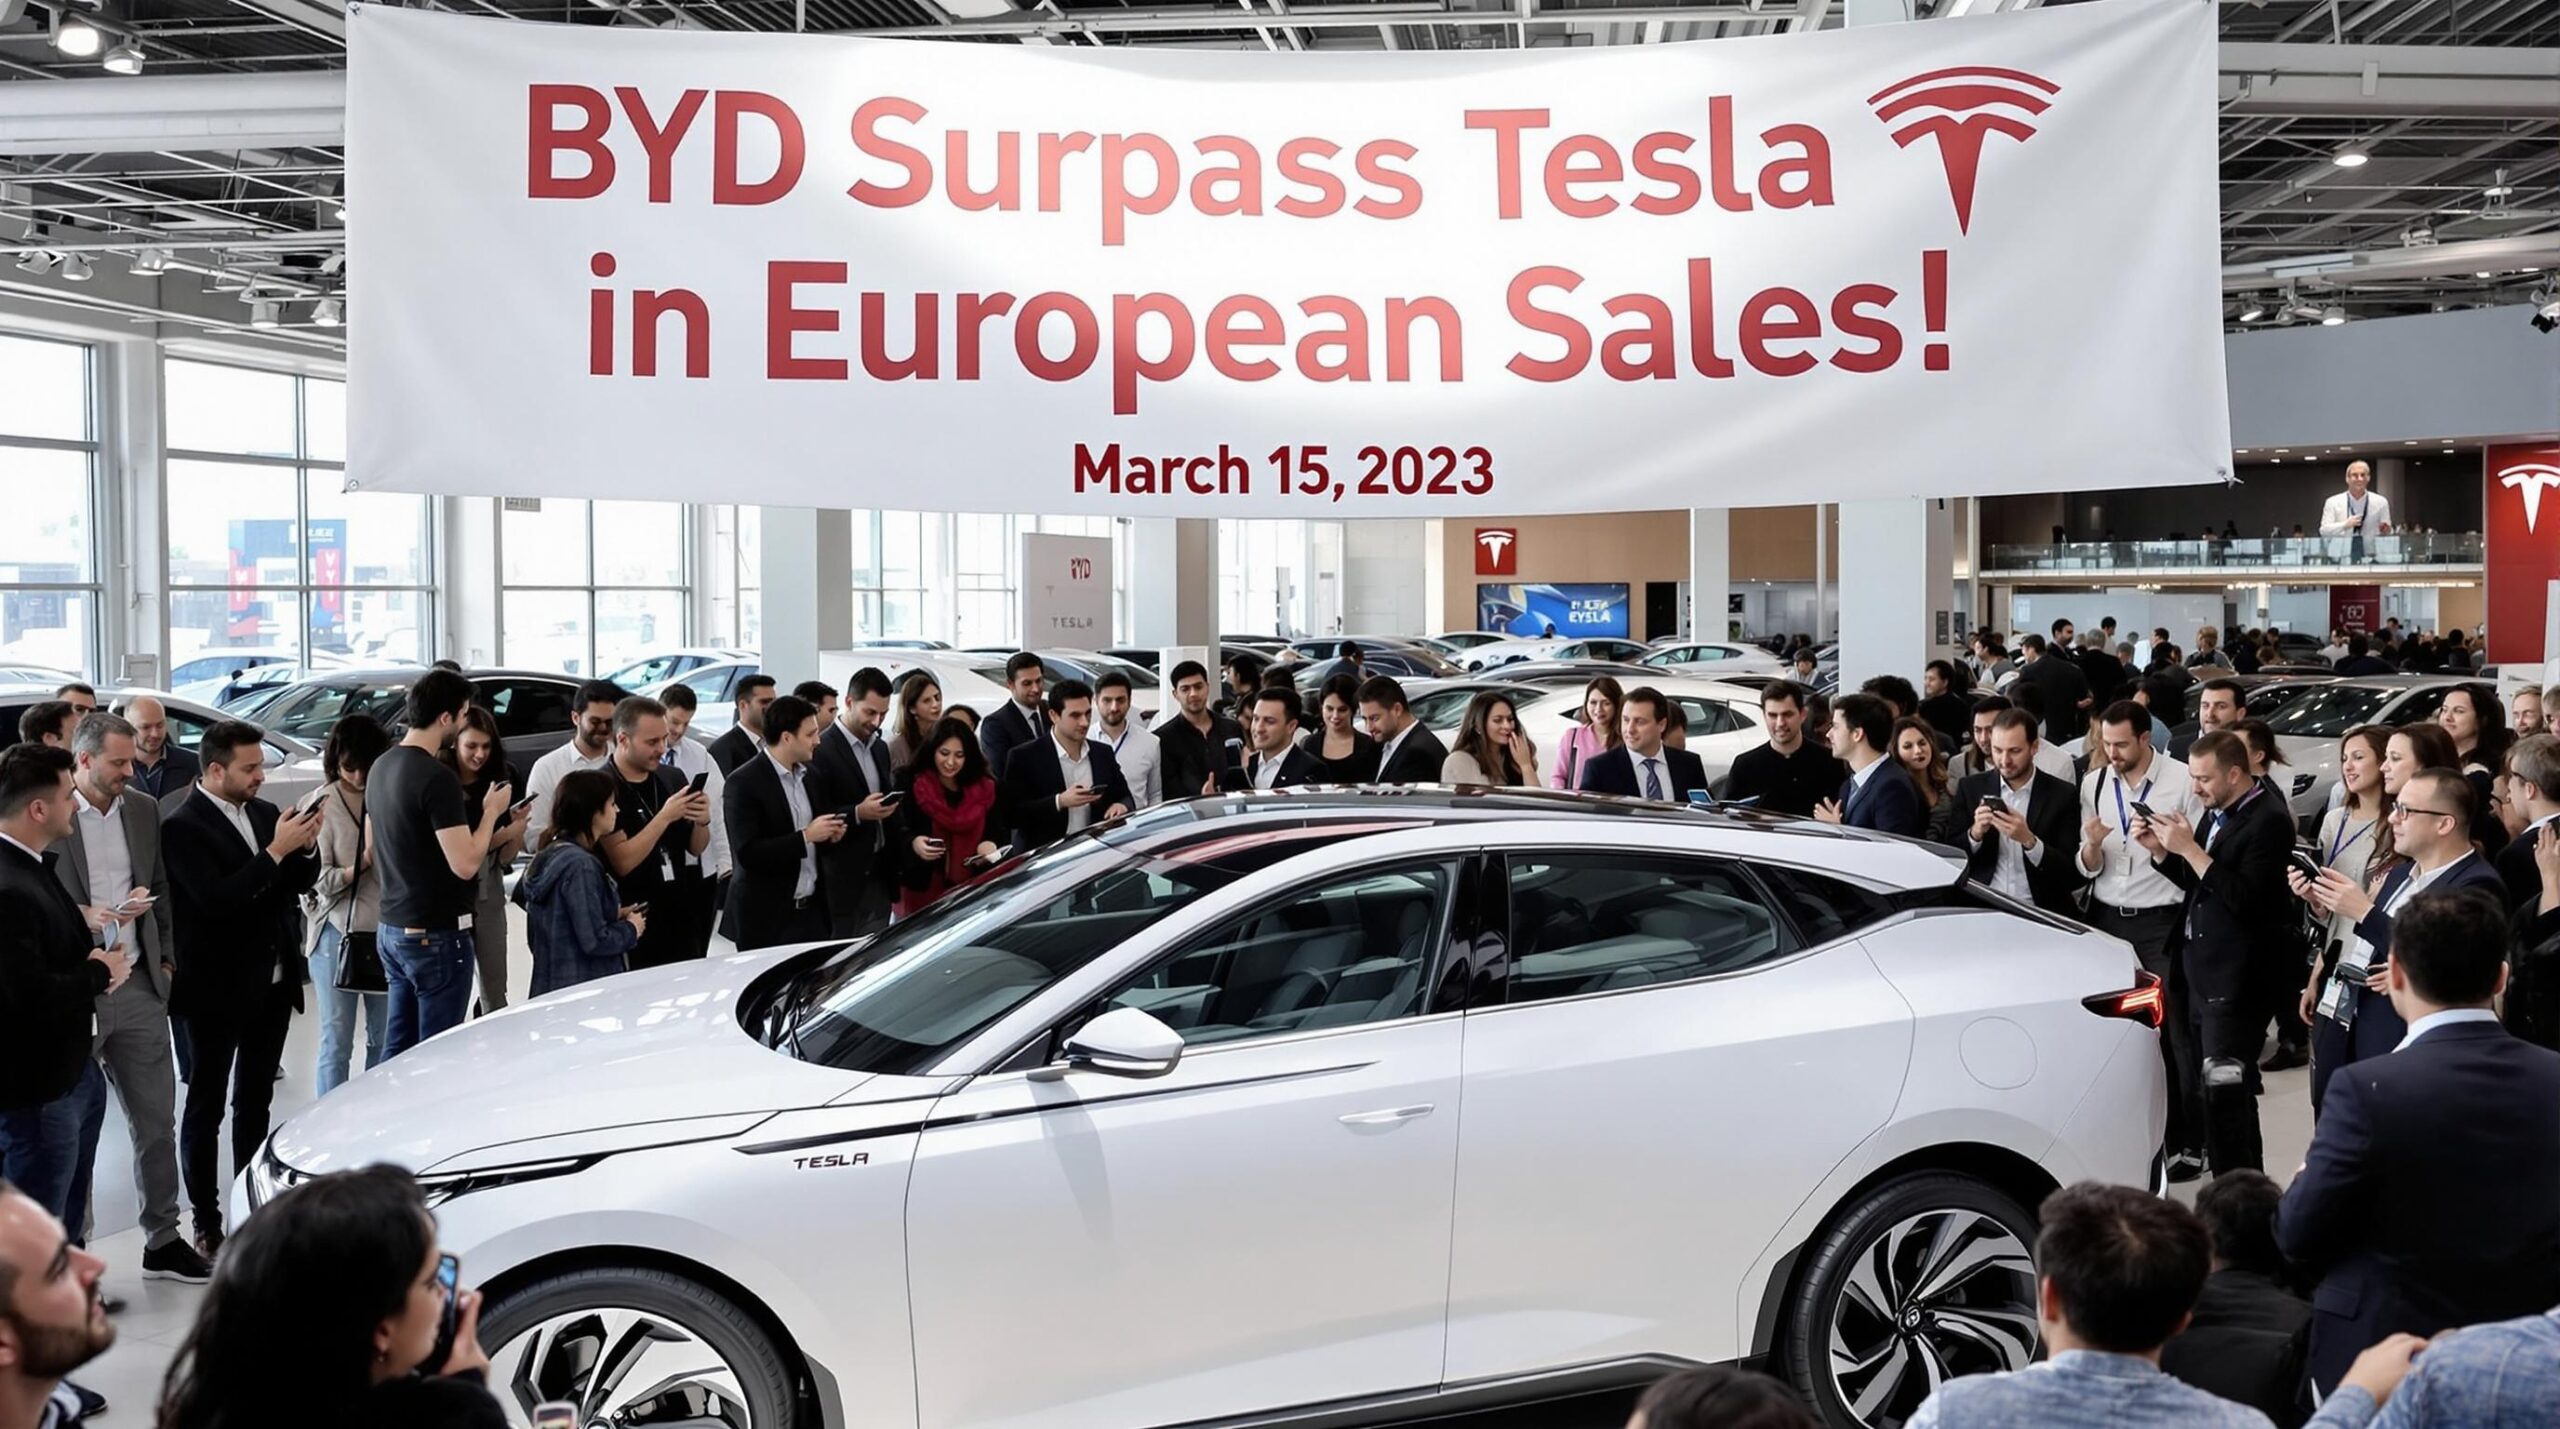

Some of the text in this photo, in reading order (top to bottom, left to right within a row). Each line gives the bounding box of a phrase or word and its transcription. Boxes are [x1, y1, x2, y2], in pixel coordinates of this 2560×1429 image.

[527, 83, 1835, 247] BYD Surpass Tesla
[588, 249, 1951, 416] in European Sales!
[1073, 443, 1494, 502] March 15, 2023
[793, 1153, 869, 1170] TESLA
